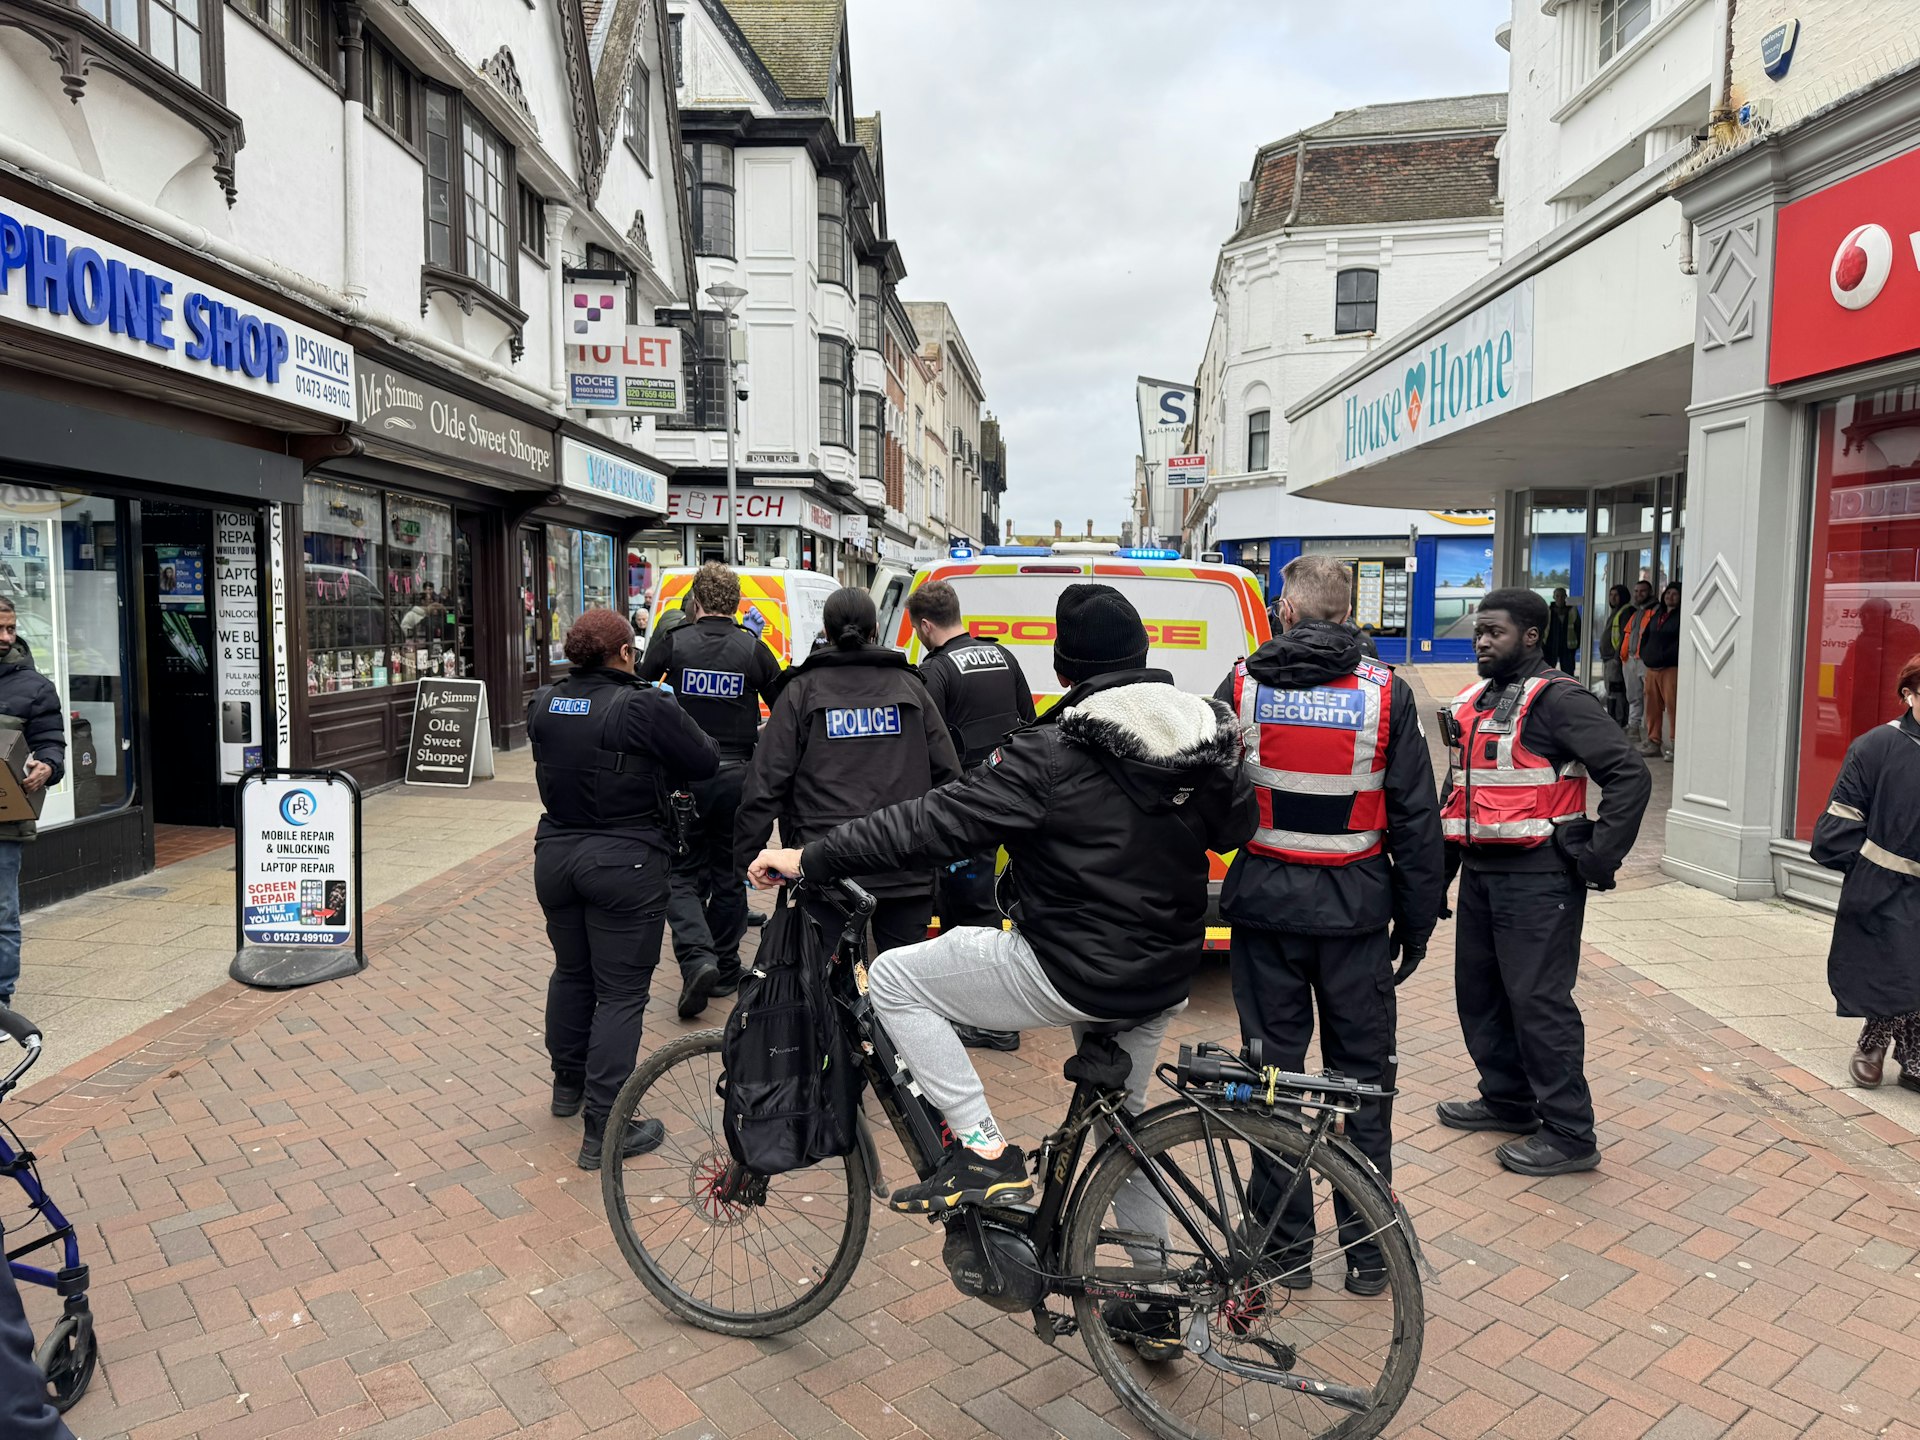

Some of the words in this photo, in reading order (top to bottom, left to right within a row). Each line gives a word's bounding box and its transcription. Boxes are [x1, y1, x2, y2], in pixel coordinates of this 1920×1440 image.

[0, 213, 175, 350] PHONE
[183, 292, 289, 383] SHOP
[295, 335, 349, 377] IPSWICH
[622, 336, 672, 367] LET
[575, 375, 615, 387] ROCHE
[295, 374, 322, 400] 01473
[323, 380, 351, 409] 499102
[627, 389, 640, 398] 020
[658, 391, 675, 400] 4848
[1345, 386, 1401, 462] House
[1428, 328, 1512, 428] Home
[360, 373, 382, 423] Mr
[385, 373, 424, 412] Simms
[430, 400, 466, 441] Olde
[469, 414, 507, 455] Sweet
[1159, 390, 1187, 425] S
[774, 455, 793, 463] LANE
[1173, 458, 1184, 466] TO
[1186, 457, 1201, 465] LET
[216, 546, 237, 555] WHILE
[237, 546, 250, 555] YOU
[273, 578, 283, 634] SELL
[219, 630, 240, 643] WE
[224, 647, 232, 660] &
[958, 646, 1004, 667] POLICE
[225, 672, 242, 680] FULL
[241, 680, 251, 688] OF
[686, 672, 742, 696] POLICE
[277, 663, 288, 746] REPAIR
[419, 691, 439, 711] Mr
[440, 690, 477, 704] Simms
[1272, 688, 1351, 708] STREET
[551, 699, 588, 712] POLICE
[1260, 703, 1362, 725] SECURITY
[428, 718, 460, 733] Olde
[830, 706, 898, 736] POLICE
[423, 734, 462, 748] Sweet
[261, 830, 297, 841] MOBILE
[300, 831, 335, 841] REPAIR
[266, 843, 273, 853] &
[277, 844, 330, 854] UNLOCKING
[260, 862, 298, 873] LAPTOP
[300, 862, 335, 874] REPAIR
[248, 881, 297, 894] SCREEN
[251, 892, 296, 905] REPAIR
[256, 904, 286, 914] WHILE
[249, 914, 270, 924] YOU
[272, 912, 295, 923] WAIT
[273, 932, 300, 942] 01473
[302, 933, 334, 943] 499102
